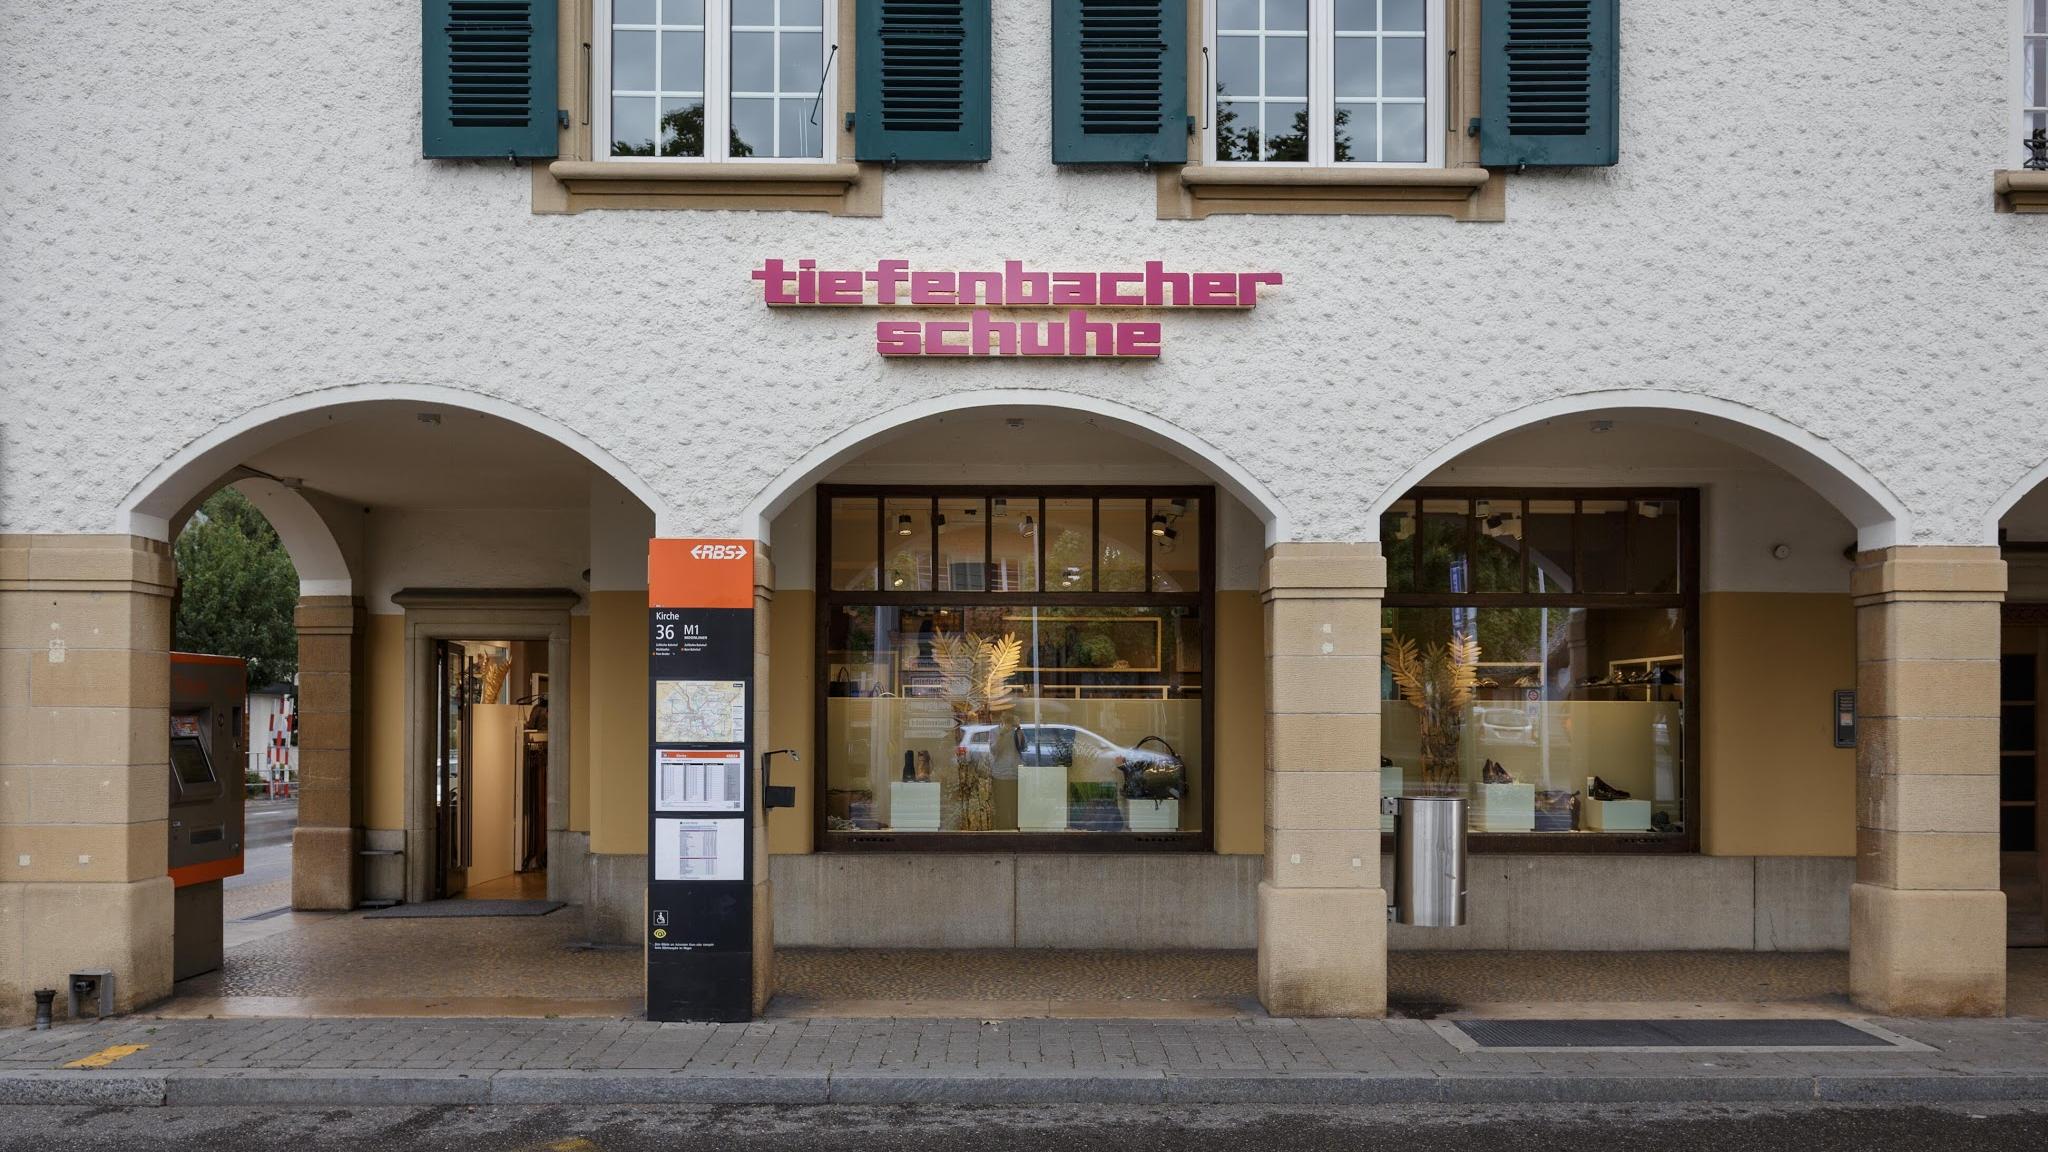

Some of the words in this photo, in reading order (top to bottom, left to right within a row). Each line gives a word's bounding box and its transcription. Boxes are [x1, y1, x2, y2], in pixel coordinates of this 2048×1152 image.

[751, 258, 1283, 306] tiefenbacher
[876, 309, 1162, 356] schuhe
[700, 544, 738, 560] RBS
[655, 611, 680, 621] Kirche
[655, 624, 675, 640] 36
[683, 624, 699, 635] M1
